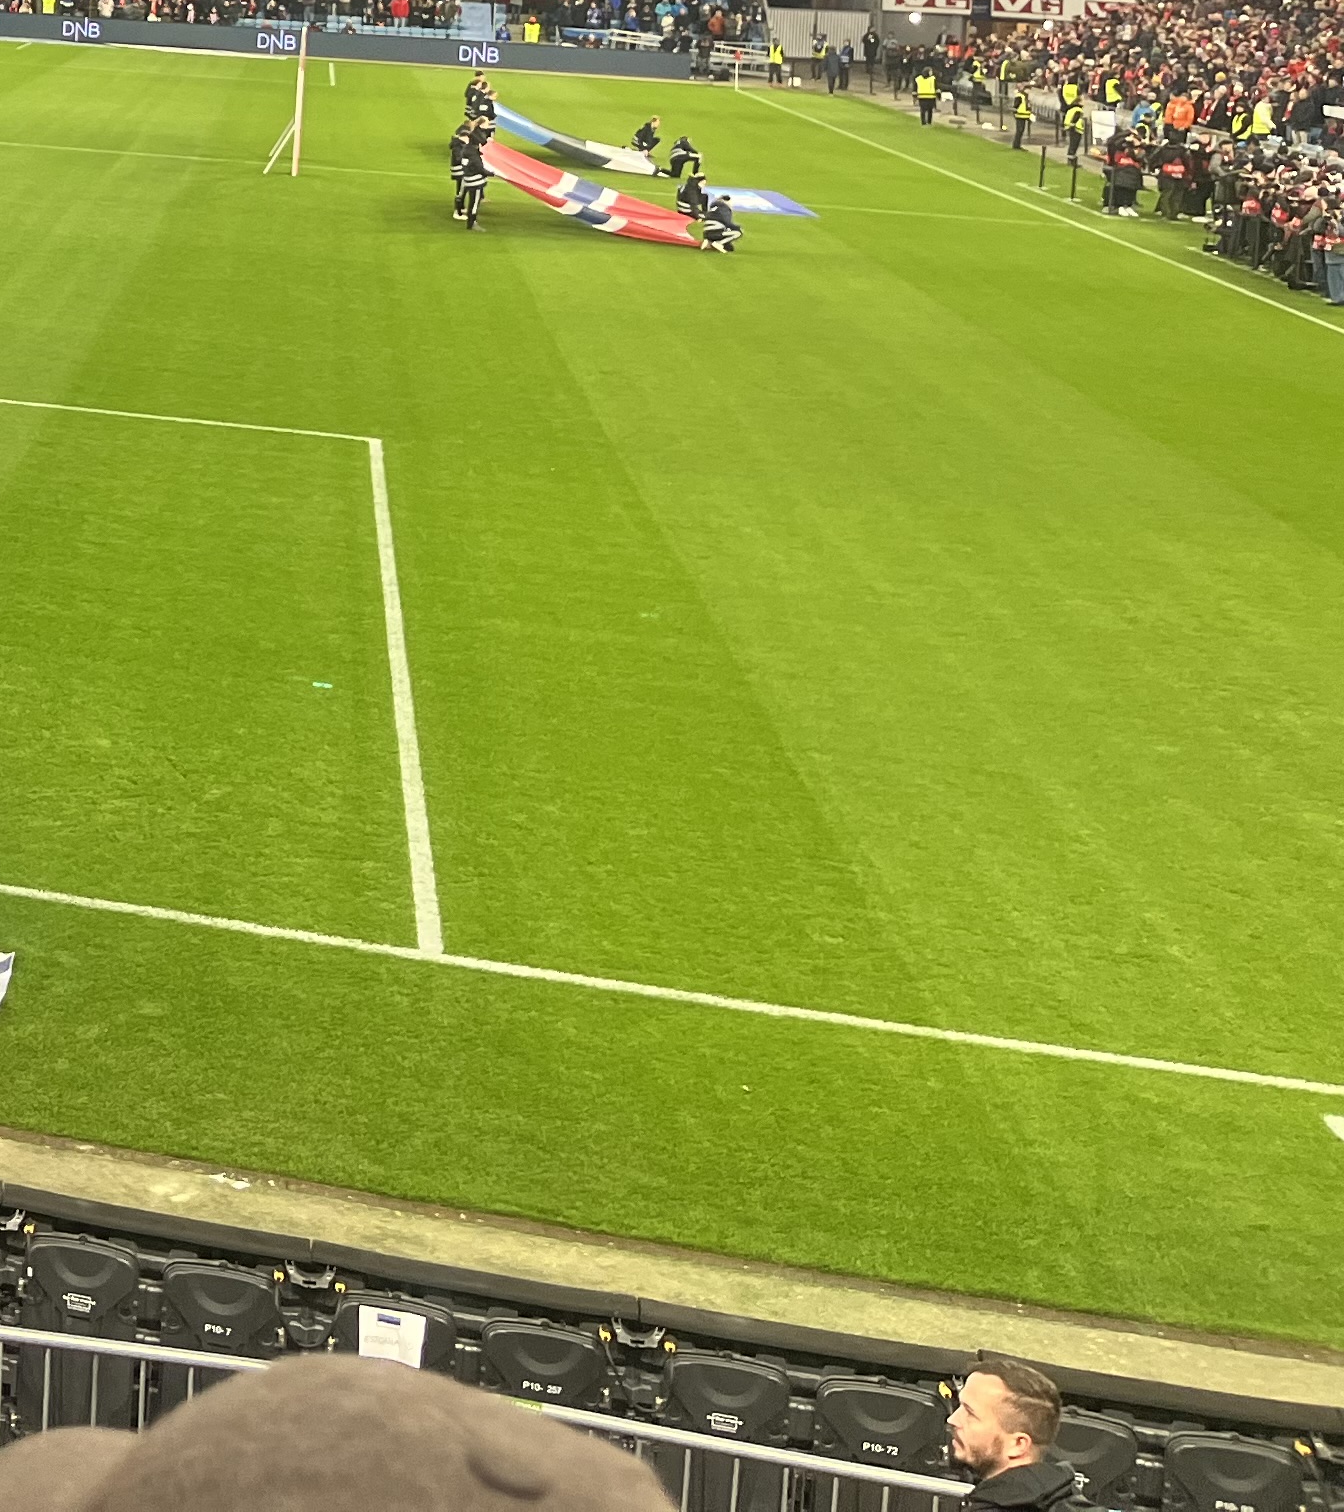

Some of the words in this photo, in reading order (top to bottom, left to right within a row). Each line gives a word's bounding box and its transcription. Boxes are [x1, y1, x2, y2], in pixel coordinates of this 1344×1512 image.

[62, 17, 100, 41] DNB
[256, 30, 297, 55] DNB
[458, 41, 500, 67] DNB
